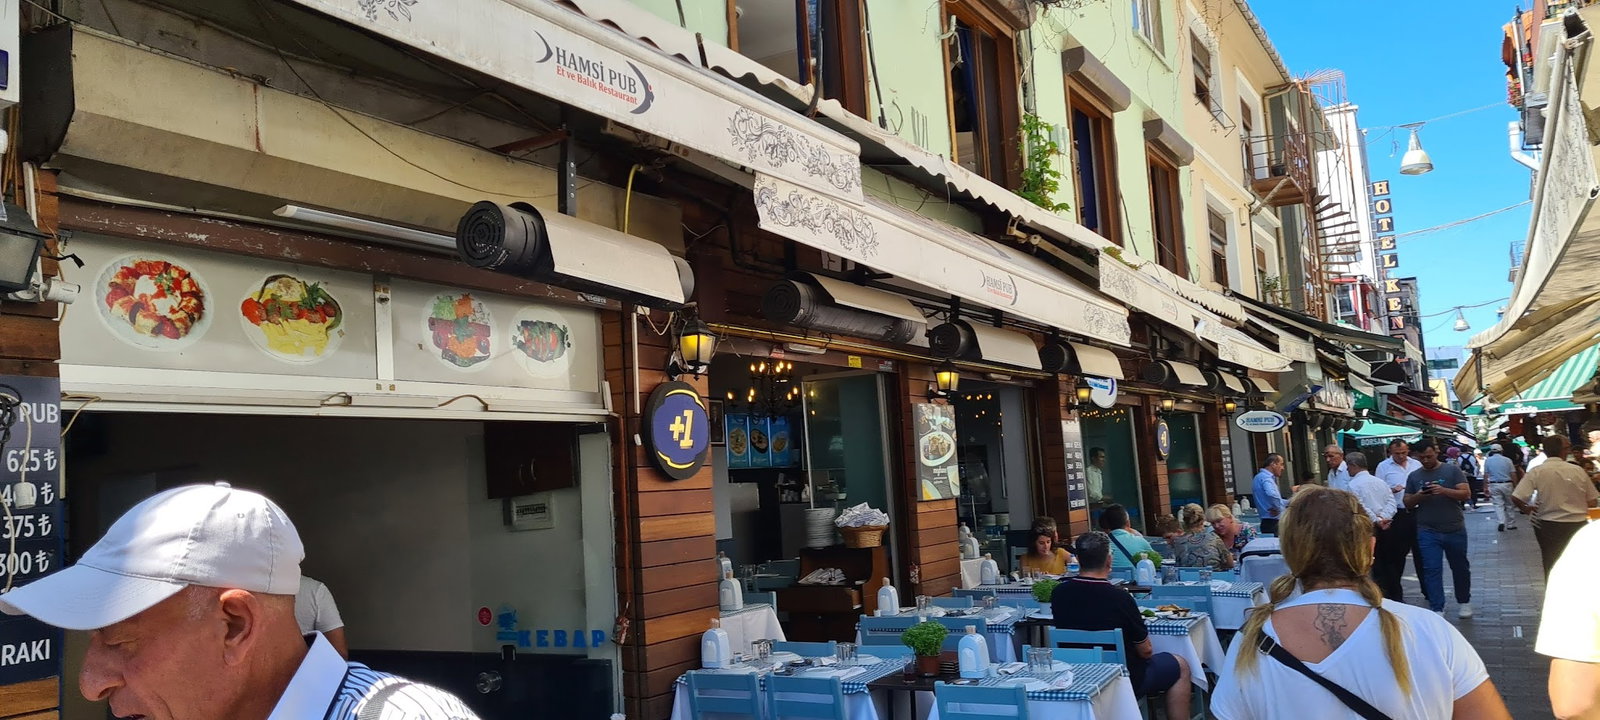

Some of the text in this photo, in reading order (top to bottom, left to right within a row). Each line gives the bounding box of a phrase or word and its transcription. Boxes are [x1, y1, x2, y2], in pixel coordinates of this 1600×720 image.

[555, 46, 637, 94] HAMSİ PUB
[556, 65, 638, 105] Et ve Balık Restaurant
[1373, 181, 1396, 268] HOTEL
[1385, 278, 1406, 341] KEN
[19, 402, 59, 424] PUB
[669, 409, 694, 449] +1
[6, 449, 41, 472] 625
[2, 514, 35, 539] 375
[1, 638, 51, 667] RAKI
[517, 629, 605, 648] KEBAP
